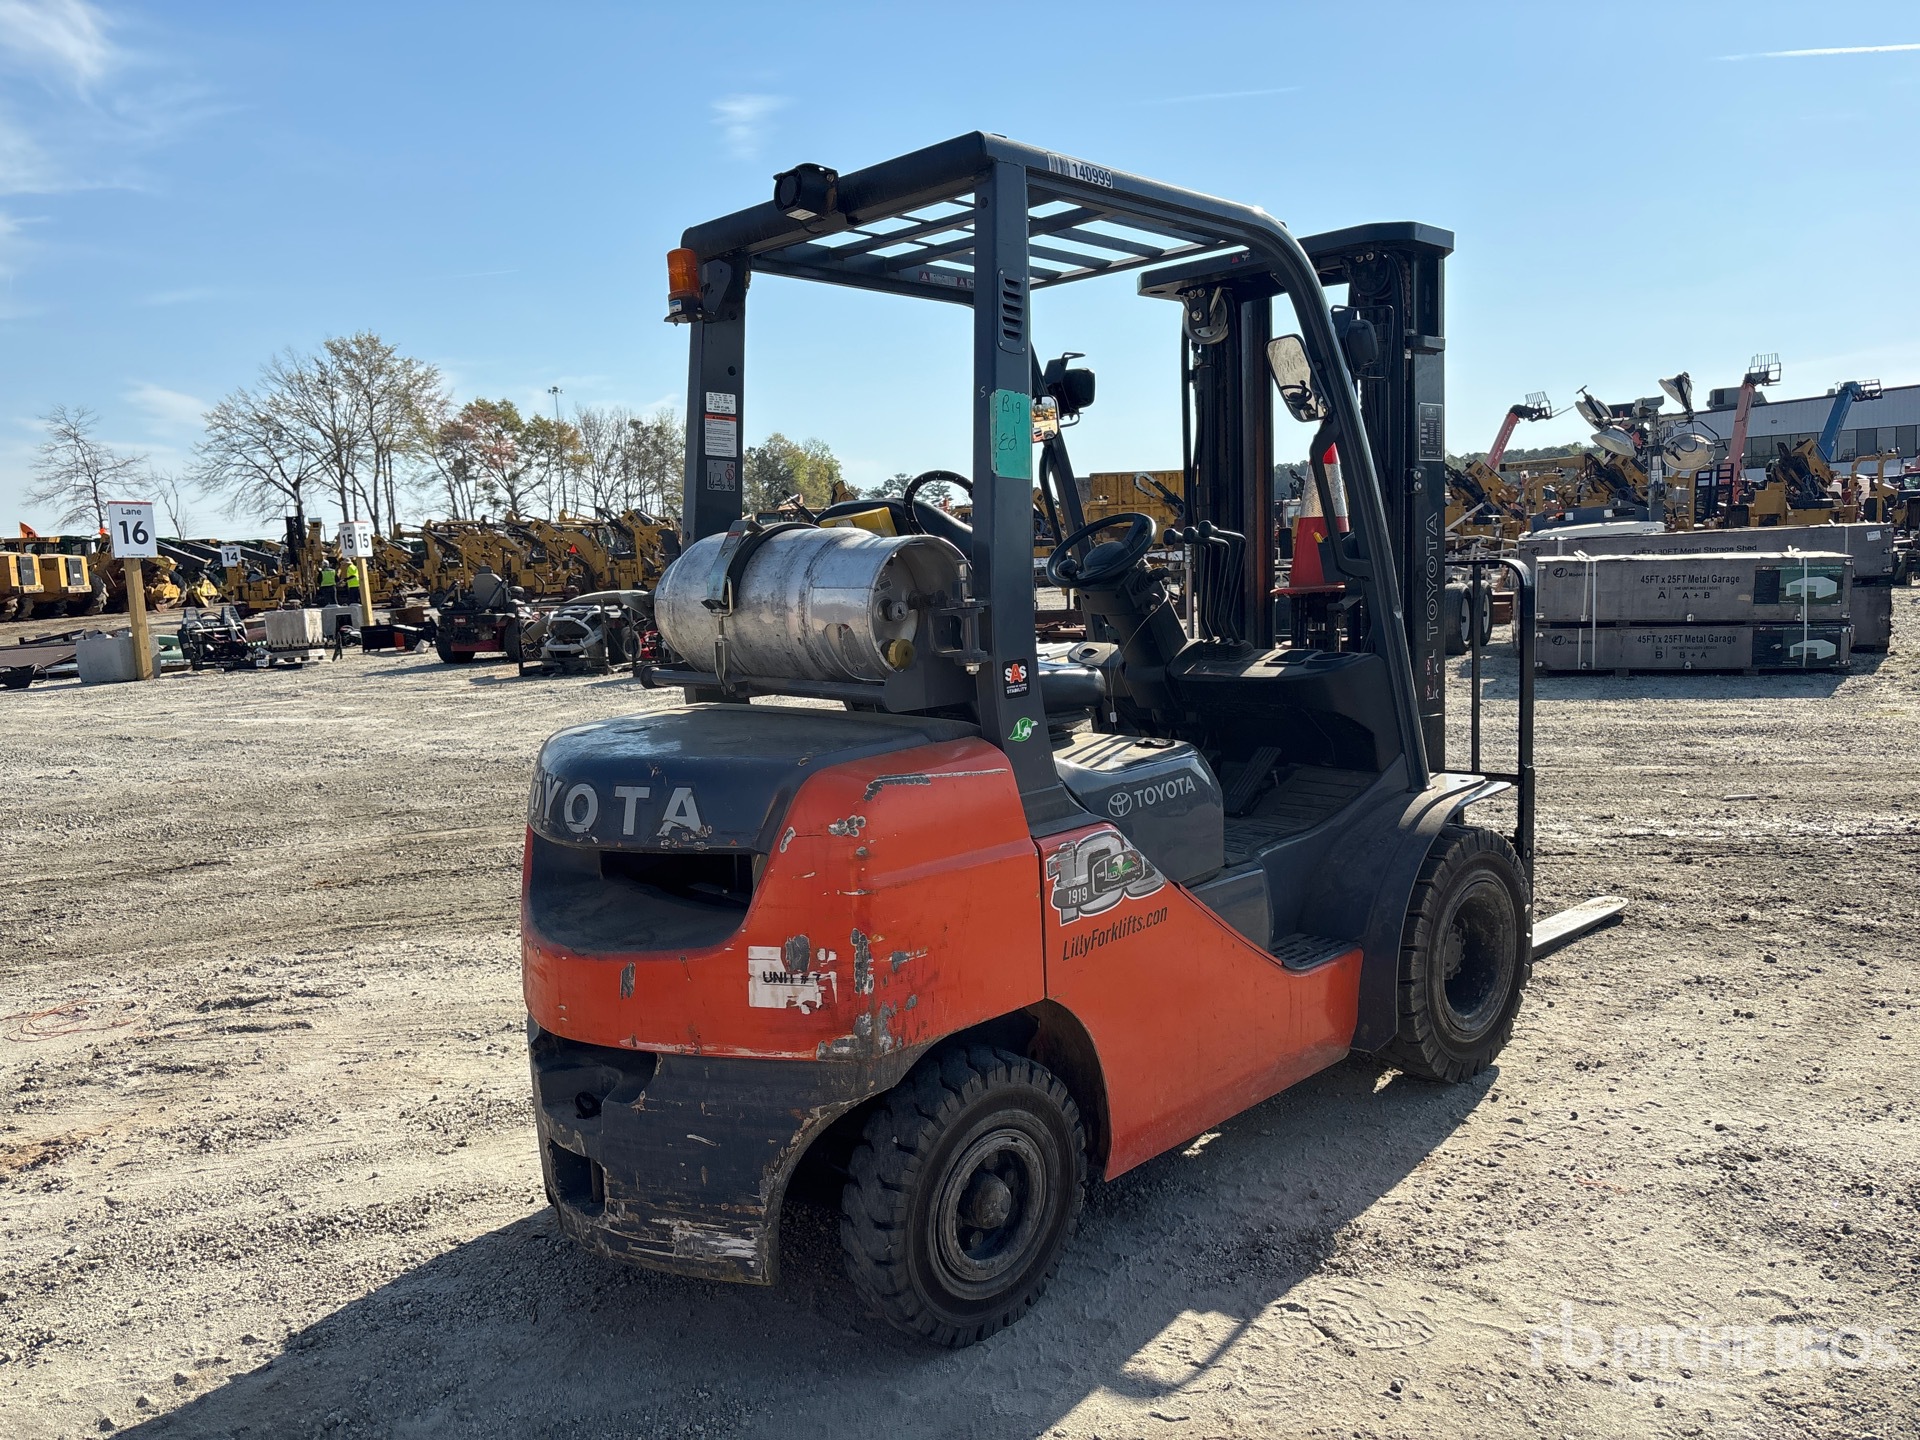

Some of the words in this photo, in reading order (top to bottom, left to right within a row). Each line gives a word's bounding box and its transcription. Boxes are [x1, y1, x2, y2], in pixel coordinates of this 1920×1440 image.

[1072, 163, 1112, 188] 140999
[1002, 394, 1021, 424] Big
[120, 507, 142, 516] Lane
[118, 520, 149, 545] 16
[358, 532, 370, 548] 15
[342, 533, 354, 550] 15
[224, 551, 239, 562] 14
[1425, 512, 1439, 642] TOYOTA
[1640, 574, 1660, 584] 45FT
[1668, 574, 1687, 584] 25FT
[1688, 574, 1710, 584] Metal
[1711, 574, 1740, 586] Garage
[1658, 591, 1666, 599] A
[1637, 634, 1656, 644] 45FT
[1664, 634, 1683, 644] 25FT
[1684, 634, 1706, 643] Metal
[1708, 634, 1737, 645] Garage
[1655, 650, 1663, 659] B
[1004, 663, 1027, 684] SAS
[1134, 775, 1196, 808] TOYOTA
[1068, 886, 1088, 905] 1919
